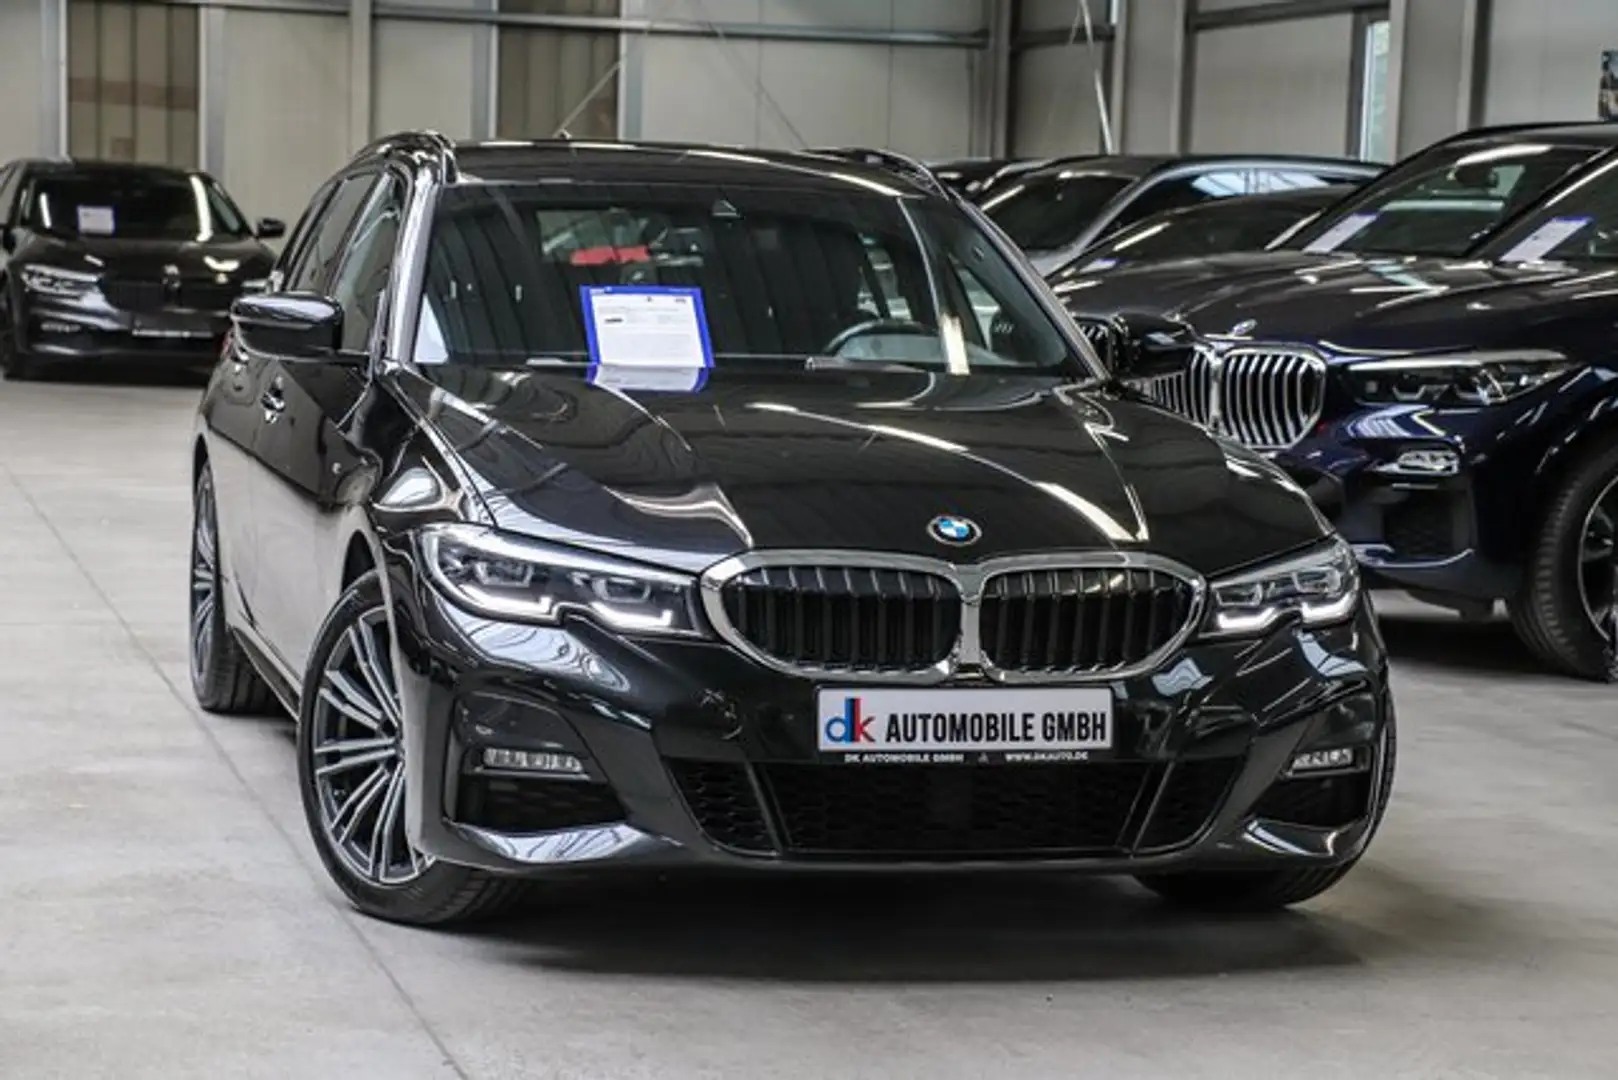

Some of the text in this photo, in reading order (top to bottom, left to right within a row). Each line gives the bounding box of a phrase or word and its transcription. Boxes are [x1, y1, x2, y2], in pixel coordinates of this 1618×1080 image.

[825, 698, 1107, 742] dk AUTOMOBILE GMBH
[844, 753, 860, 763] DK
[861, 753, 930, 763] AUTOMOBILE
